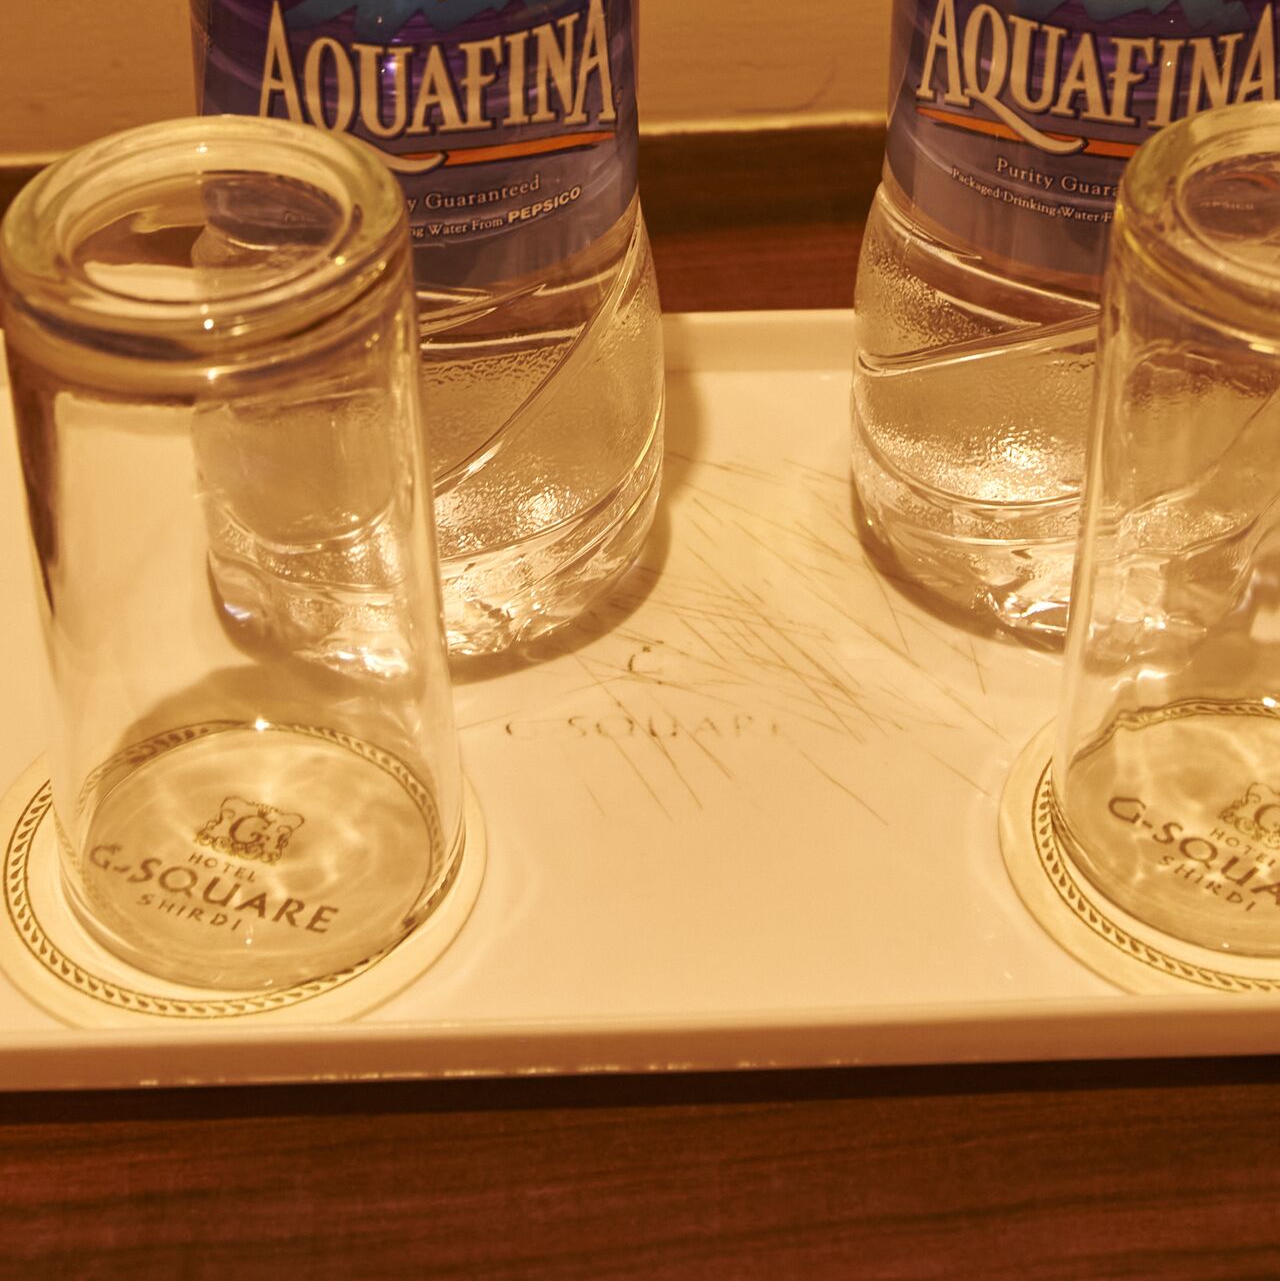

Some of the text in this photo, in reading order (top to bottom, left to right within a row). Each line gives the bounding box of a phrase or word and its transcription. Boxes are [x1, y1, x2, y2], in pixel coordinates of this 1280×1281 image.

[425, 174, 540, 209] Guaranteed
[951, 168, 1000, 199] Packaged
[1003, 190, 1057, 216] Drinking
[1059, 206, 1099, 222] Water
[996, 157, 1118, 197] Purity Guara
[428, 223, 467, 236] Water
[472, 219, 503, 231] From
[508, 186, 582, 224] PEPSICO
[1209, 827, 1276, 867] HOTEL
[188, 852, 256, 883] HOTEL
[1158, 855, 1256, 912] SHIRDI
[89, 844, 339, 933] G-SQUARE
[136, 893, 242, 931] SHIRDI
